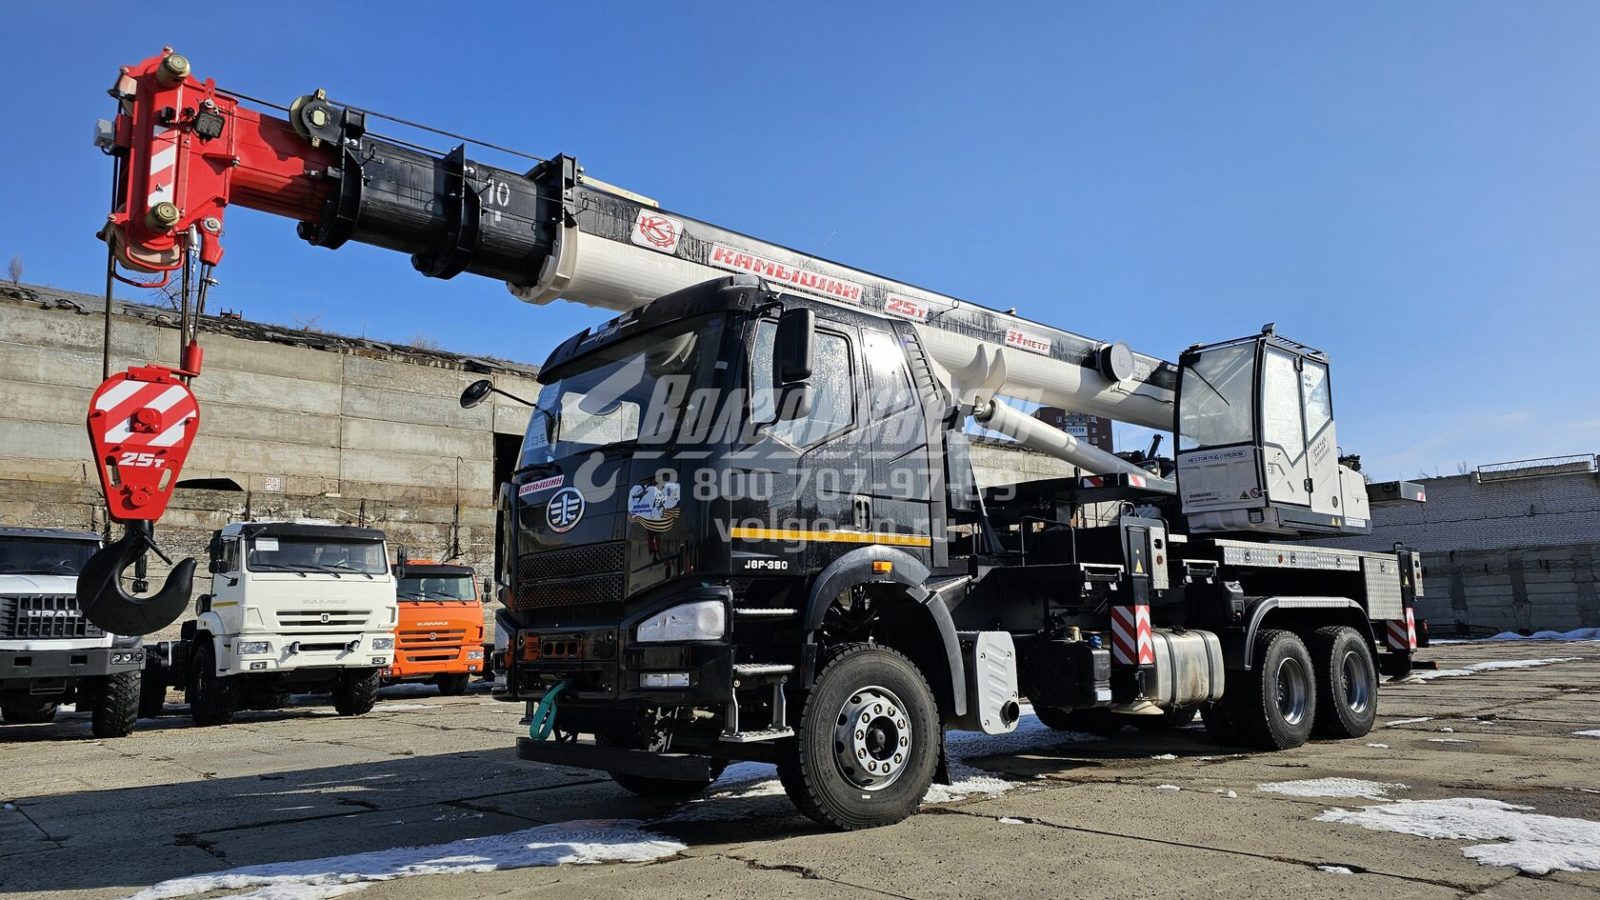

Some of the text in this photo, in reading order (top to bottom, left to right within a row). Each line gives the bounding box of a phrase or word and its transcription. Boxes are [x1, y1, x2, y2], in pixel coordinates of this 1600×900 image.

[488, 178, 510, 207] 10
[713, 246, 860, 301] КАМЫШИН
[27, 609, 81, 618] URAL
